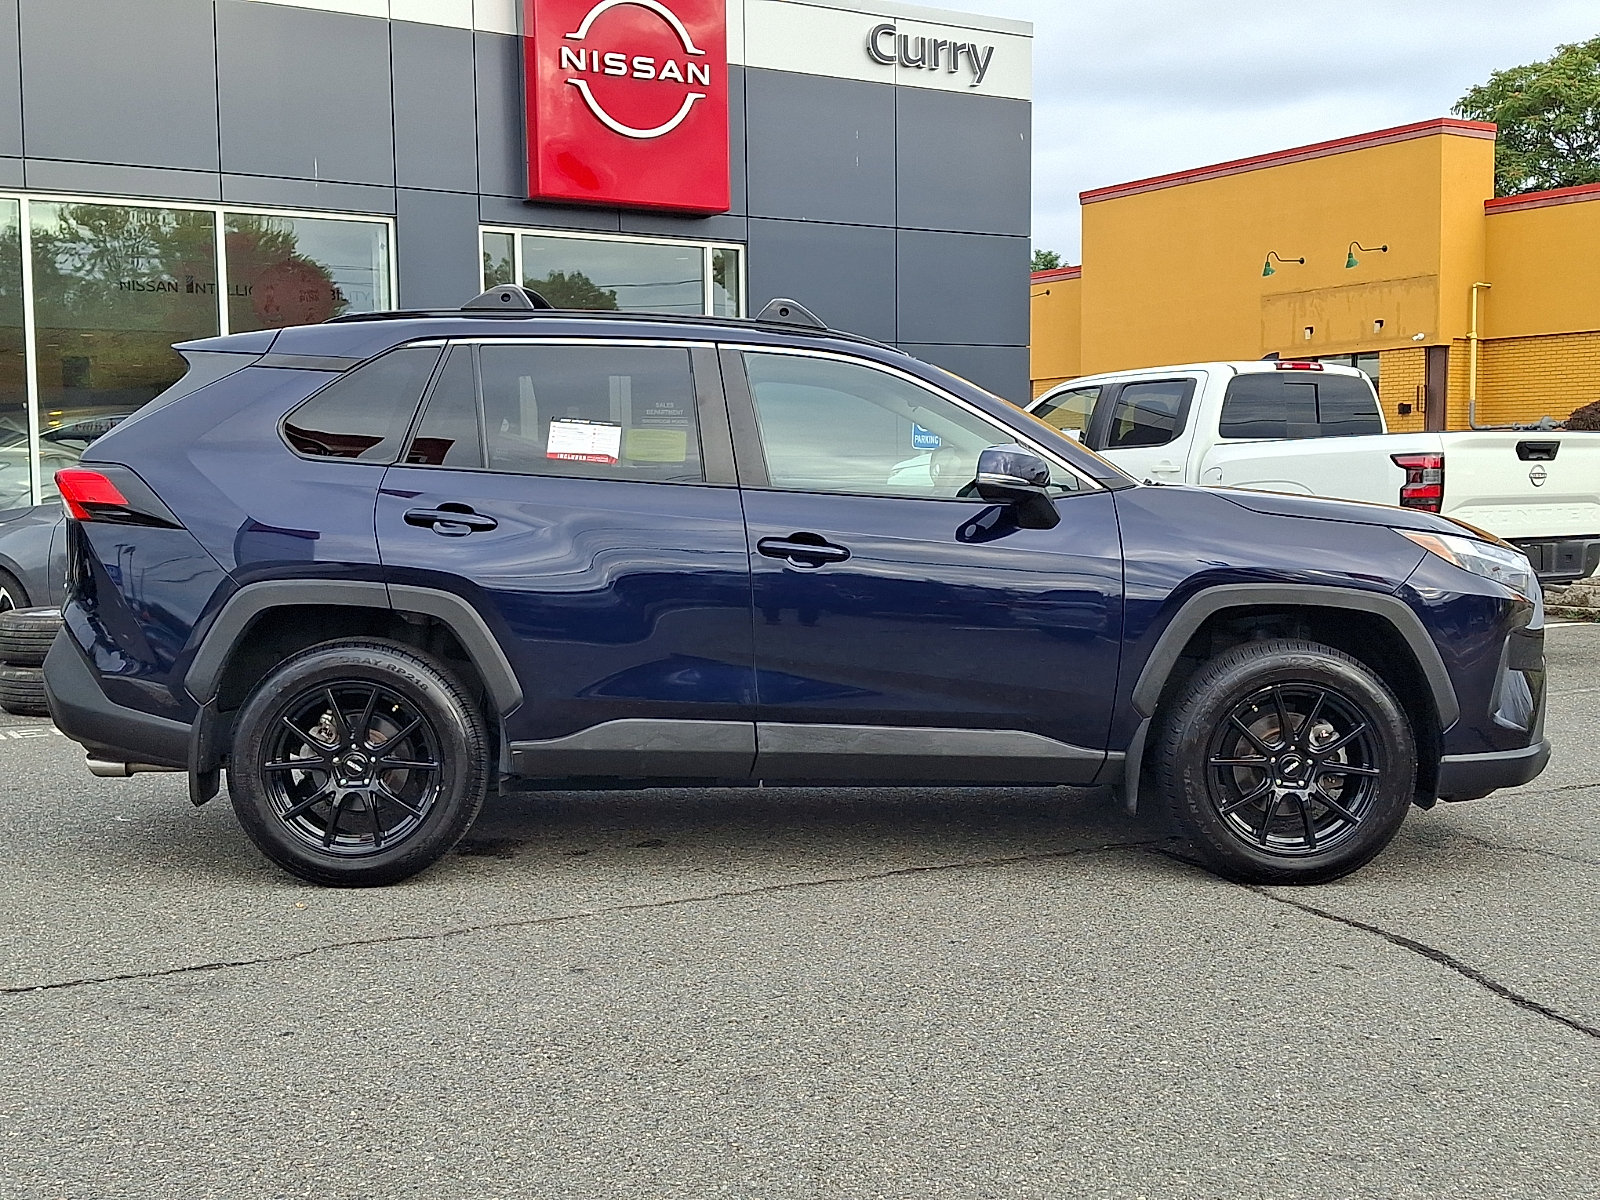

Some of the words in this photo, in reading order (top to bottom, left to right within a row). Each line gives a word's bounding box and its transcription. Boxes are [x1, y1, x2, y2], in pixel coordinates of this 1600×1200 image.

[559, 45, 710, 86] NISSAN
[866, 23, 994, 87] Curry
[119, 280, 179, 293] NISSAN
[914, 435, 939, 444] PARKING
